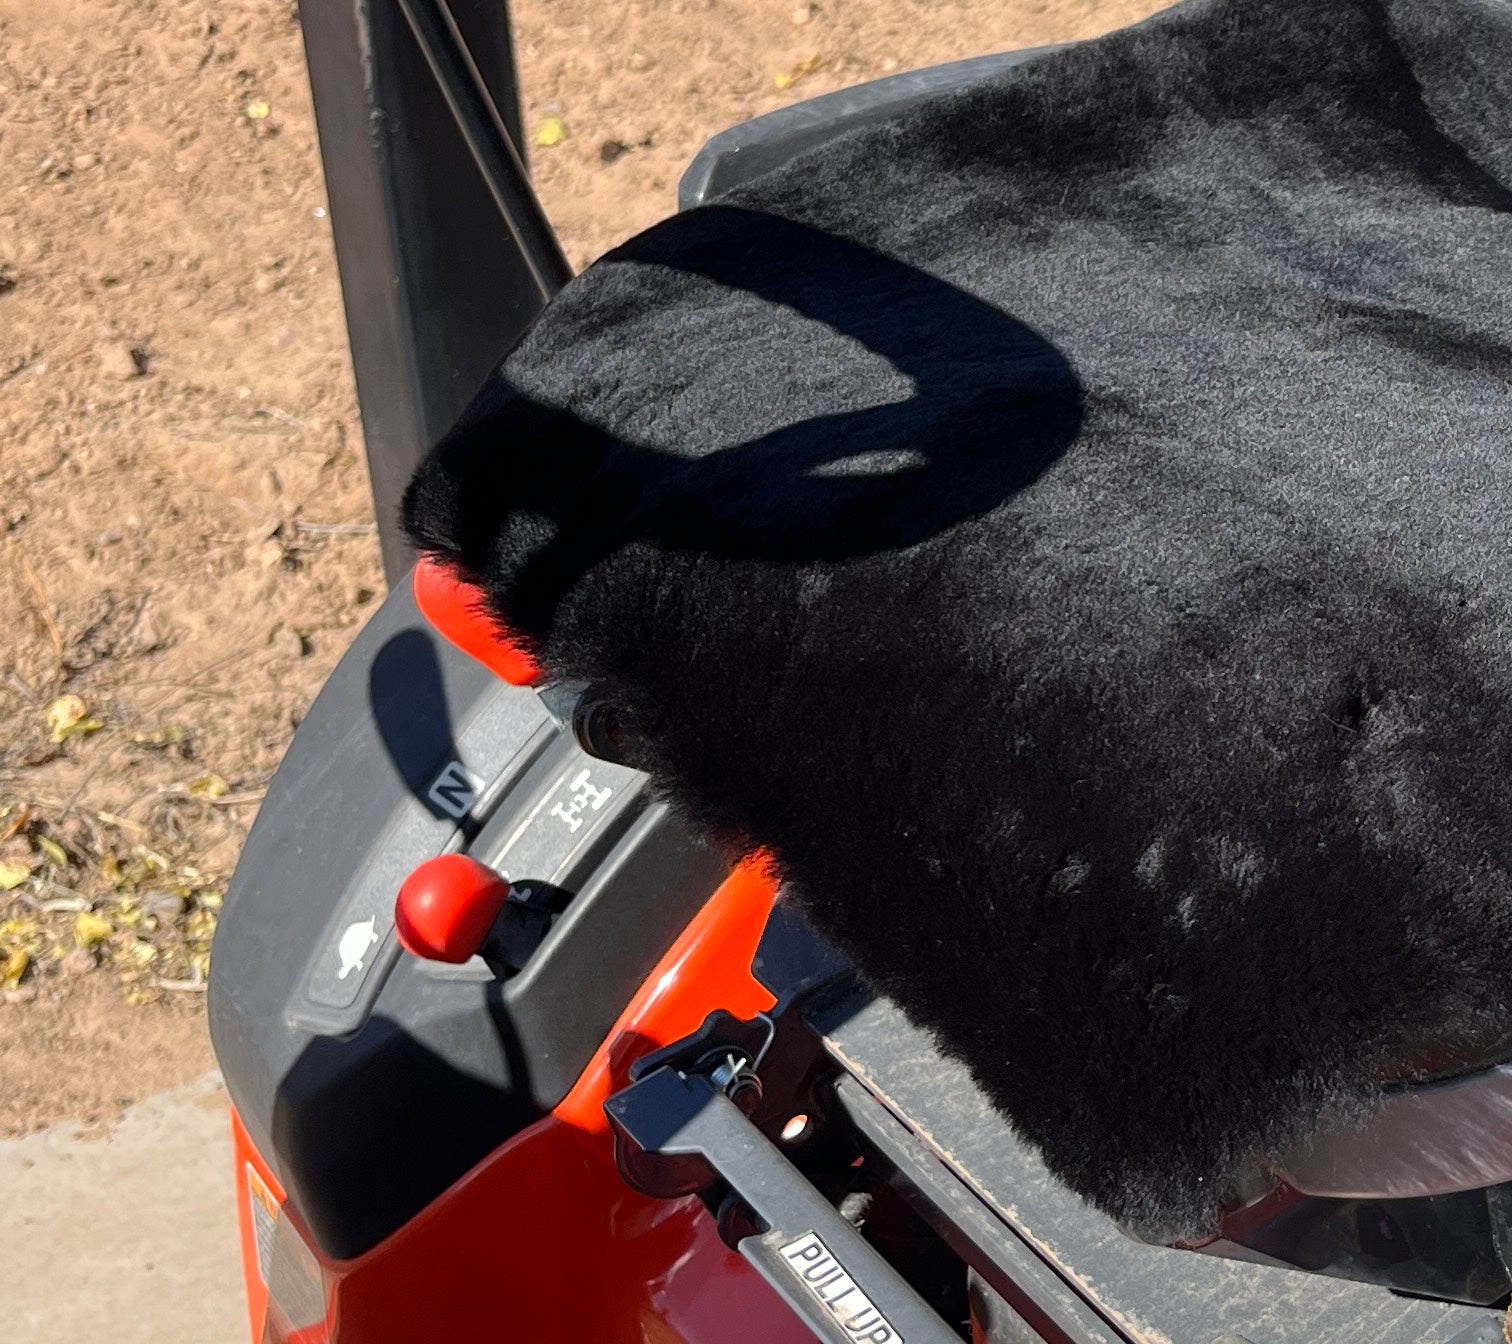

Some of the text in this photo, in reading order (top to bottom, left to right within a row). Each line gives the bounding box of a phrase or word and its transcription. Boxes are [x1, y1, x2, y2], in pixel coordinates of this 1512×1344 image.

[436, 768, 473, 810] N
[787, 1241, 892, 1344] PULL UP
